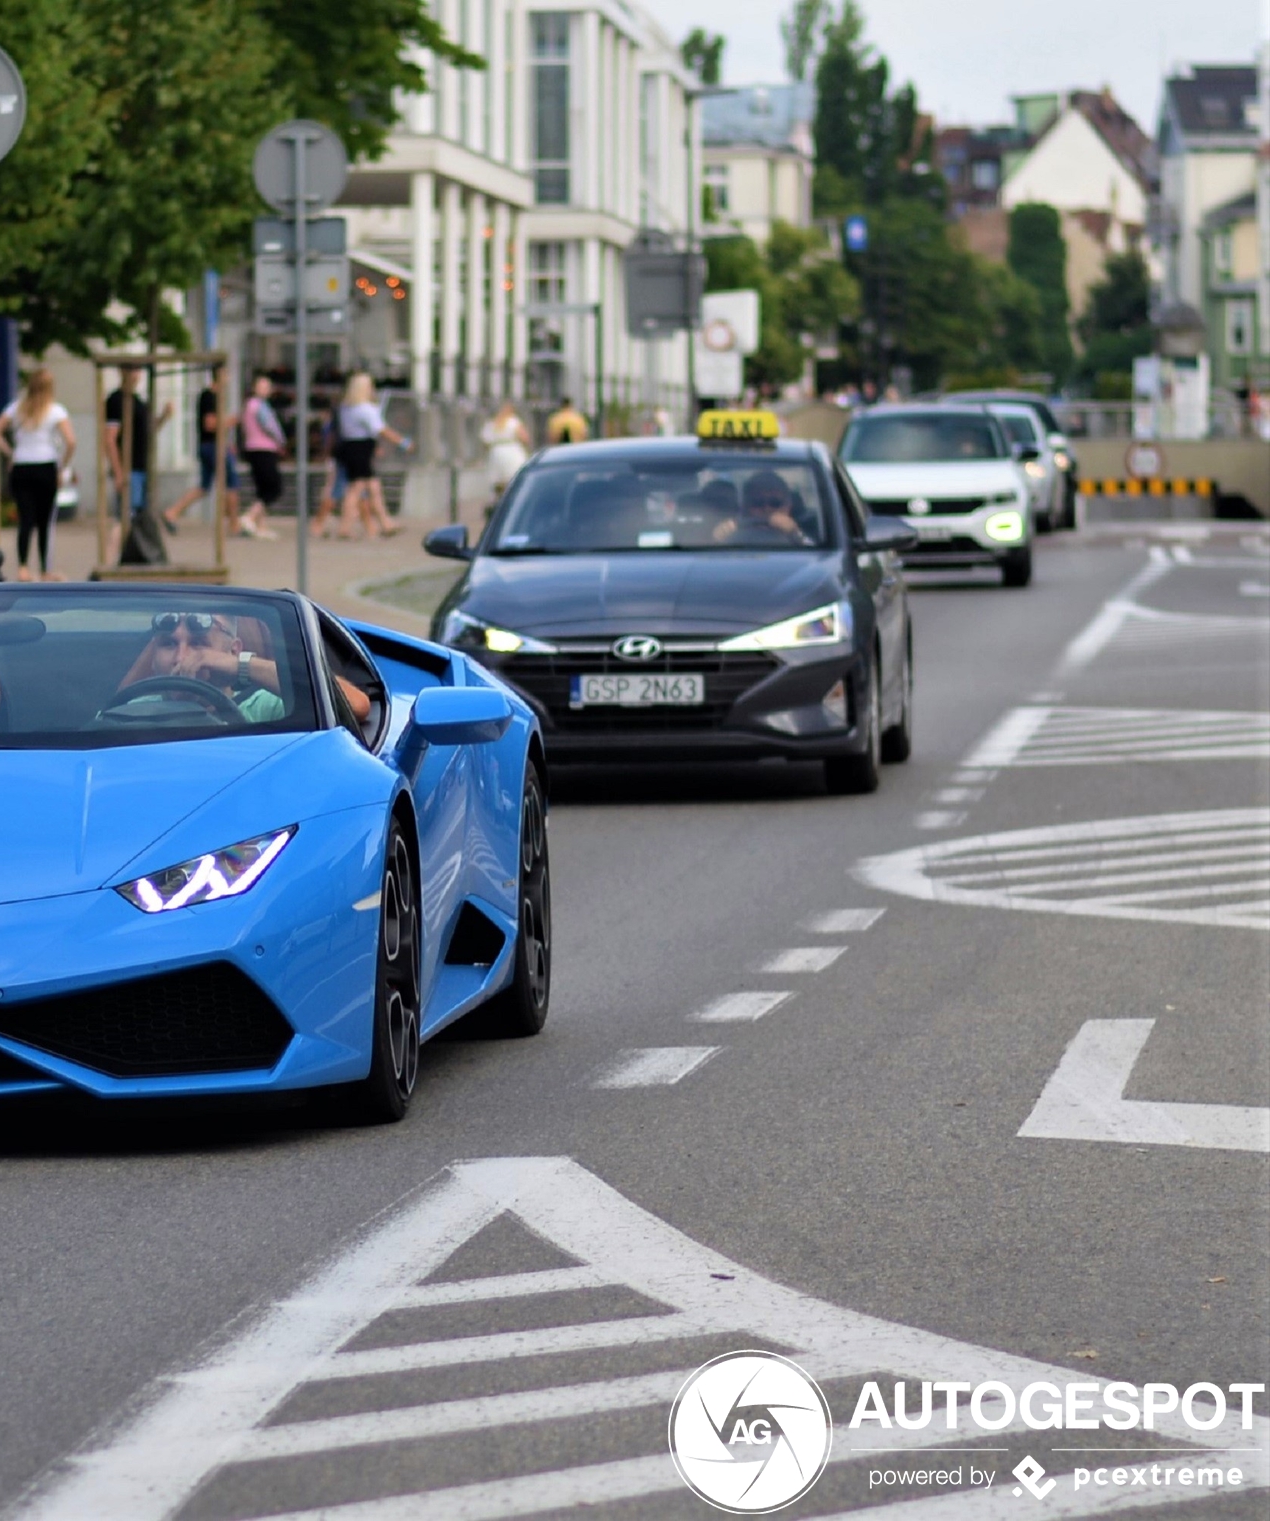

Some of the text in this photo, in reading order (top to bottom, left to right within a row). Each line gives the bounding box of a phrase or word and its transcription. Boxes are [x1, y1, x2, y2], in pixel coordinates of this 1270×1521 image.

[710, 418, 763, 438] TAXI
[586, 678, 630, 701] GSP
[639, 678, 698, 701] 2N63
